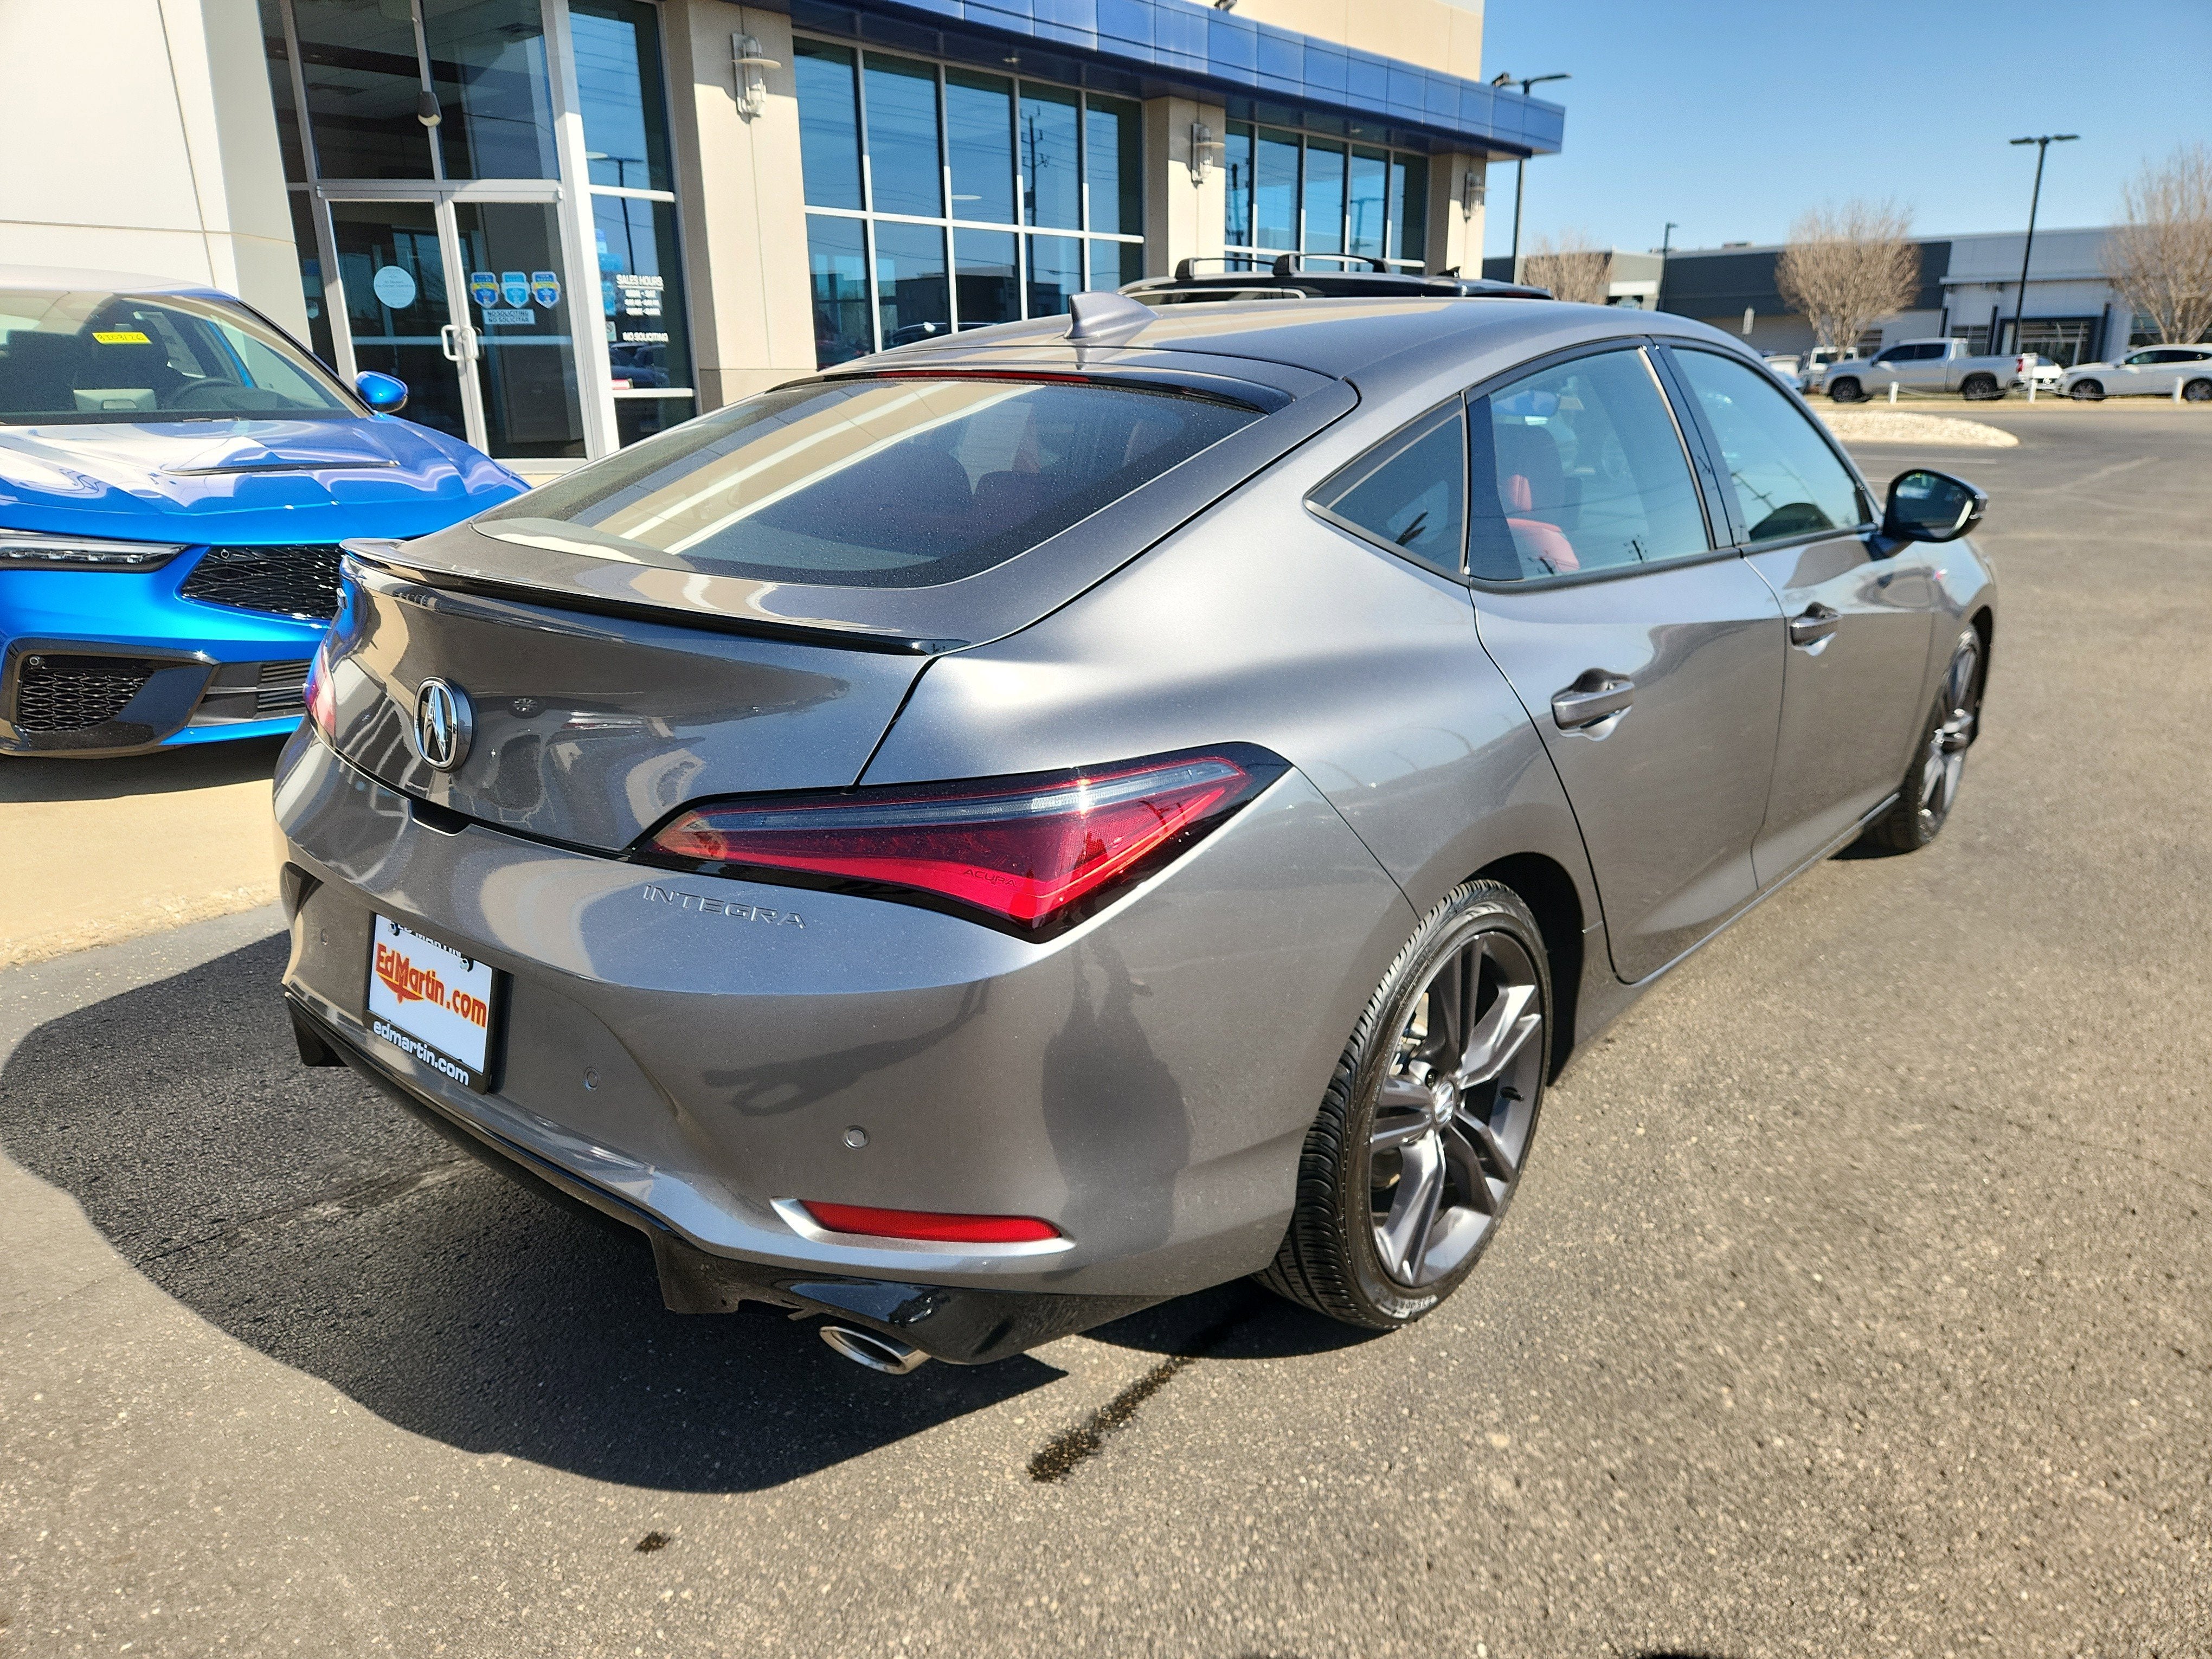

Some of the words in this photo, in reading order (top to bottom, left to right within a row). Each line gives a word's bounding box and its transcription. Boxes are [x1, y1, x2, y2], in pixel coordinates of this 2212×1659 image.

[616, 274, 639, 285] SALES
[639, 275, 664, 286] HOURS
[622, 332, 634, 341] NO
[634, 332, 668, 342] SOLICITING
[963, 869, 1017, 887] ACURA
[643, 885, 806, 929] INTEGRA
[373, 1020, 470, 1086] edmartin.com
